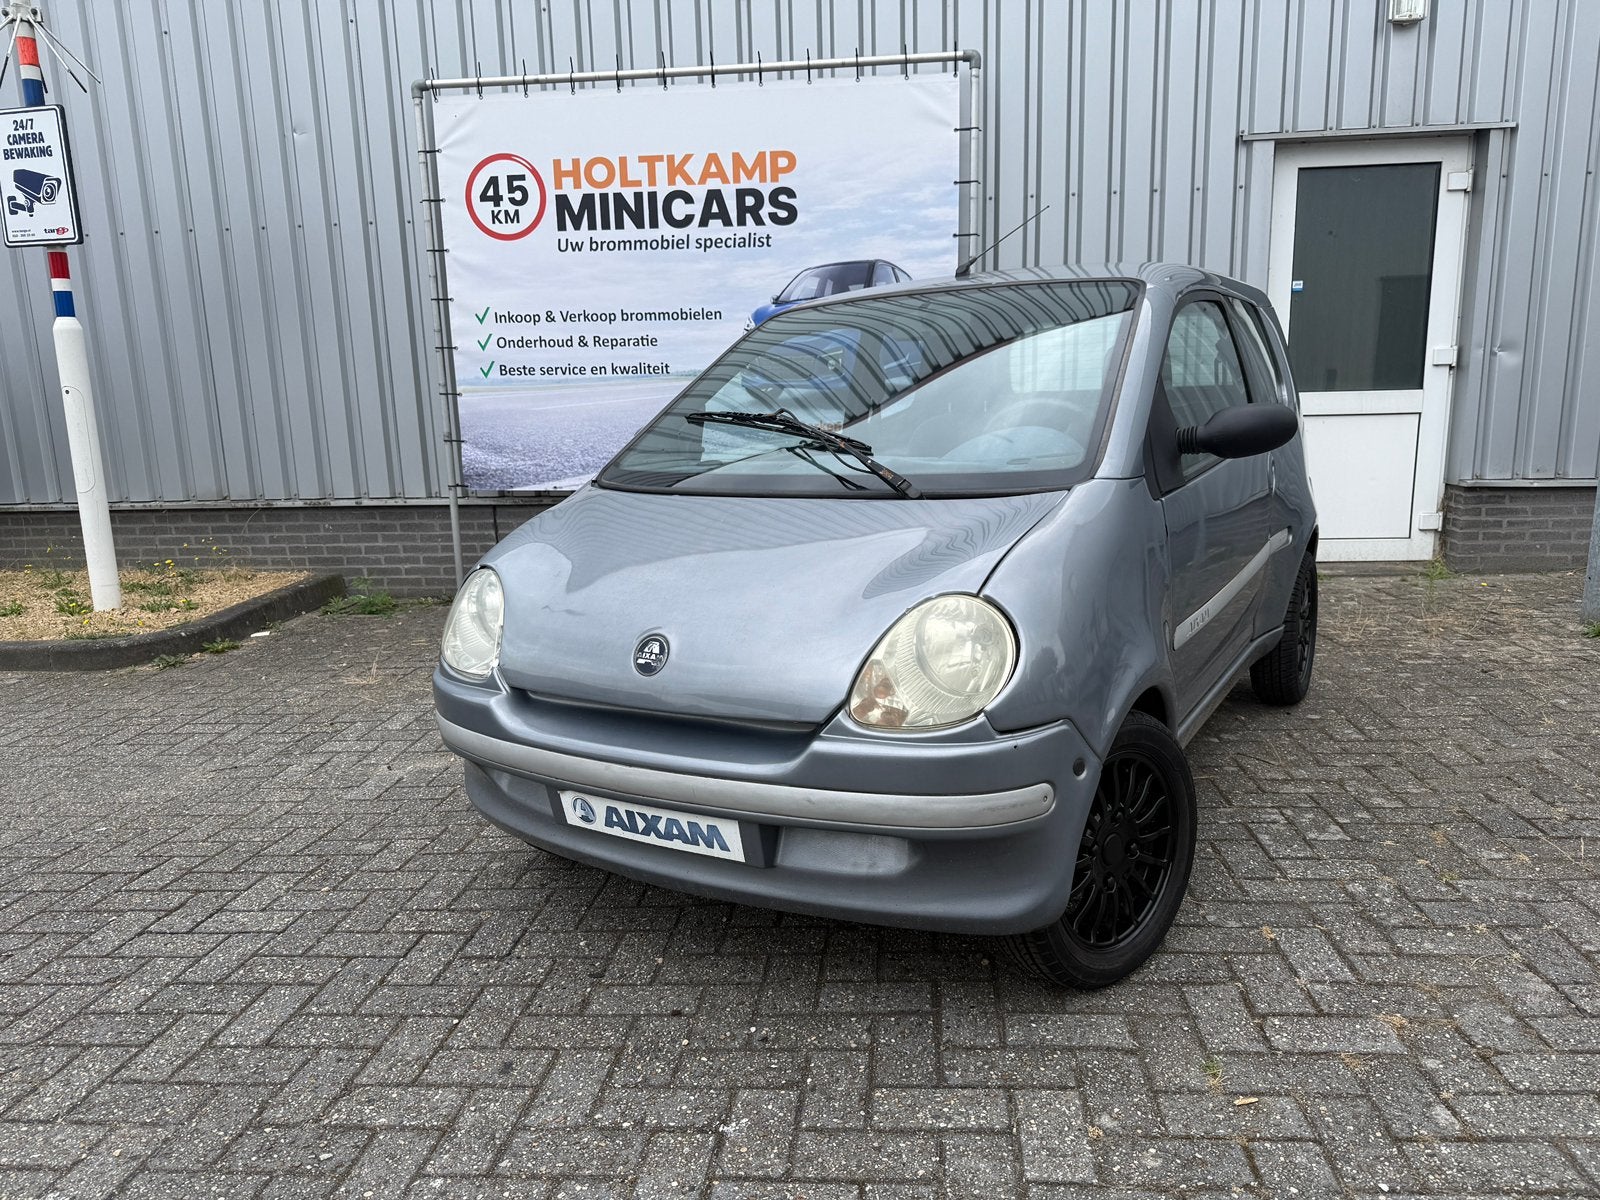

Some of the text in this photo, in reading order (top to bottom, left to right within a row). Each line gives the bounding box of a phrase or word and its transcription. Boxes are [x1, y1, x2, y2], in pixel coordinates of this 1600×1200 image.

[13, 118, 34, 131] 24/7
[7, 132, 45, 146] CAMERA
[3, 145, 53, 160] BEWAKING
[553, 150, 797, 190] HOLTKAMP
[479, 174, 529, 208] 45
[491, 209, 521, 225] KM
[555, 186, 798, 232] MINICARS
[558, 232, 772, 252] Uw brommobiel specialist
[495, 307, 722, 326] Inkoop & Verkoop brommobielen
[497, 334, 658, 351] Onderhoud & Reparatie
[499, 362, 670, 376] Beste service en kwaliteit
[605, 806, 731, 852] AIXAM
